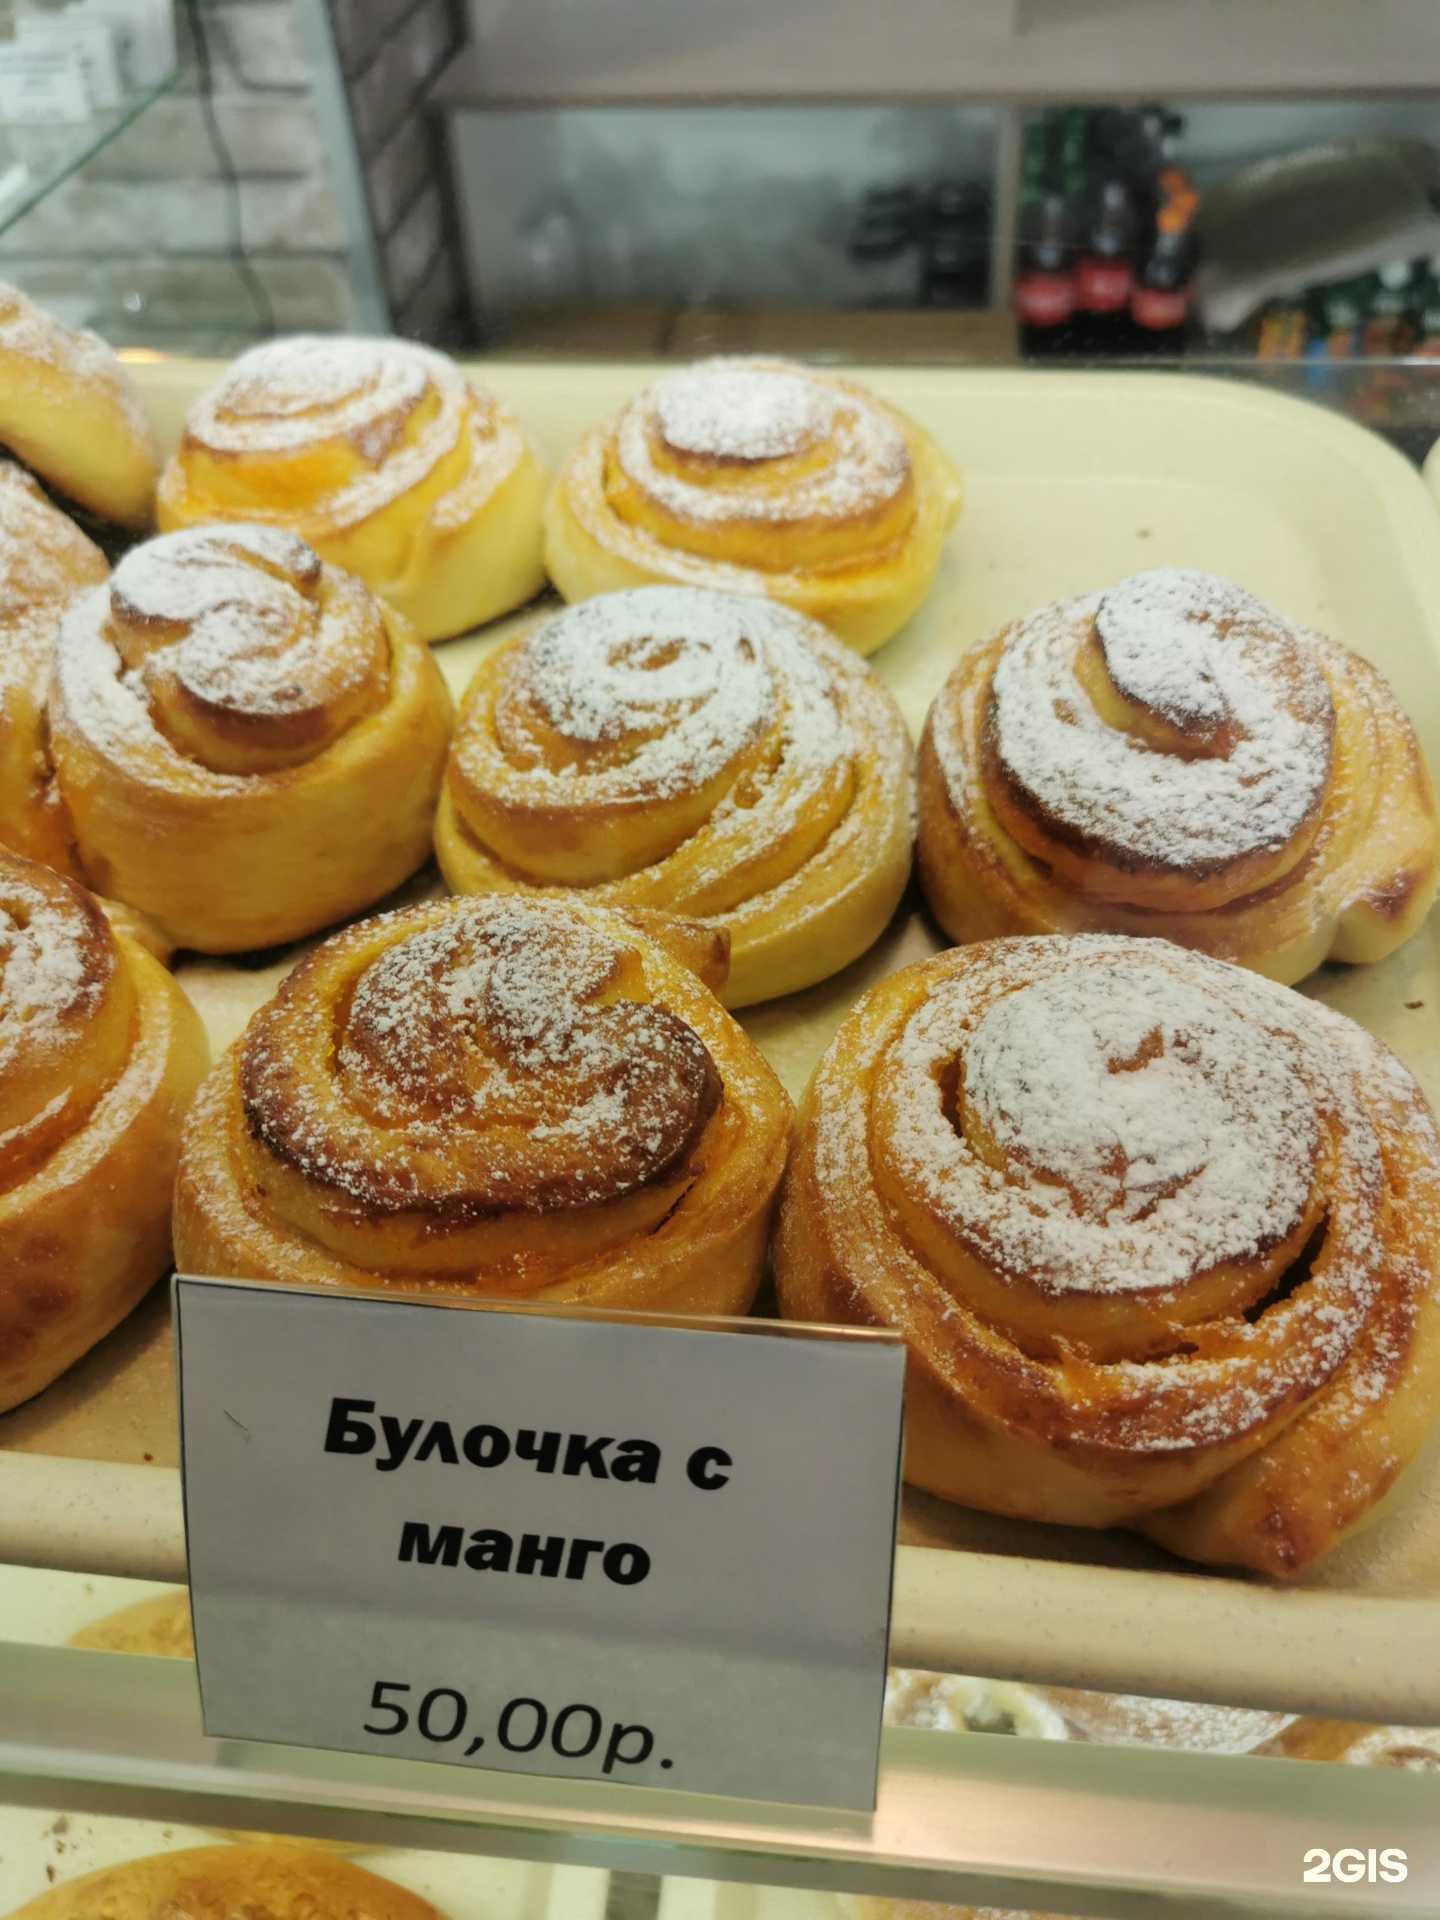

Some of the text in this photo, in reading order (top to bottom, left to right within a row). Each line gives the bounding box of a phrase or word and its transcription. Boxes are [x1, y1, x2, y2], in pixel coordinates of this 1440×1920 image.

[323, 1397, 734, 1491] Булочка с
[397, 1521, 652, 1586] манго
[362, 1680, 674, 1774] 50,00р.
